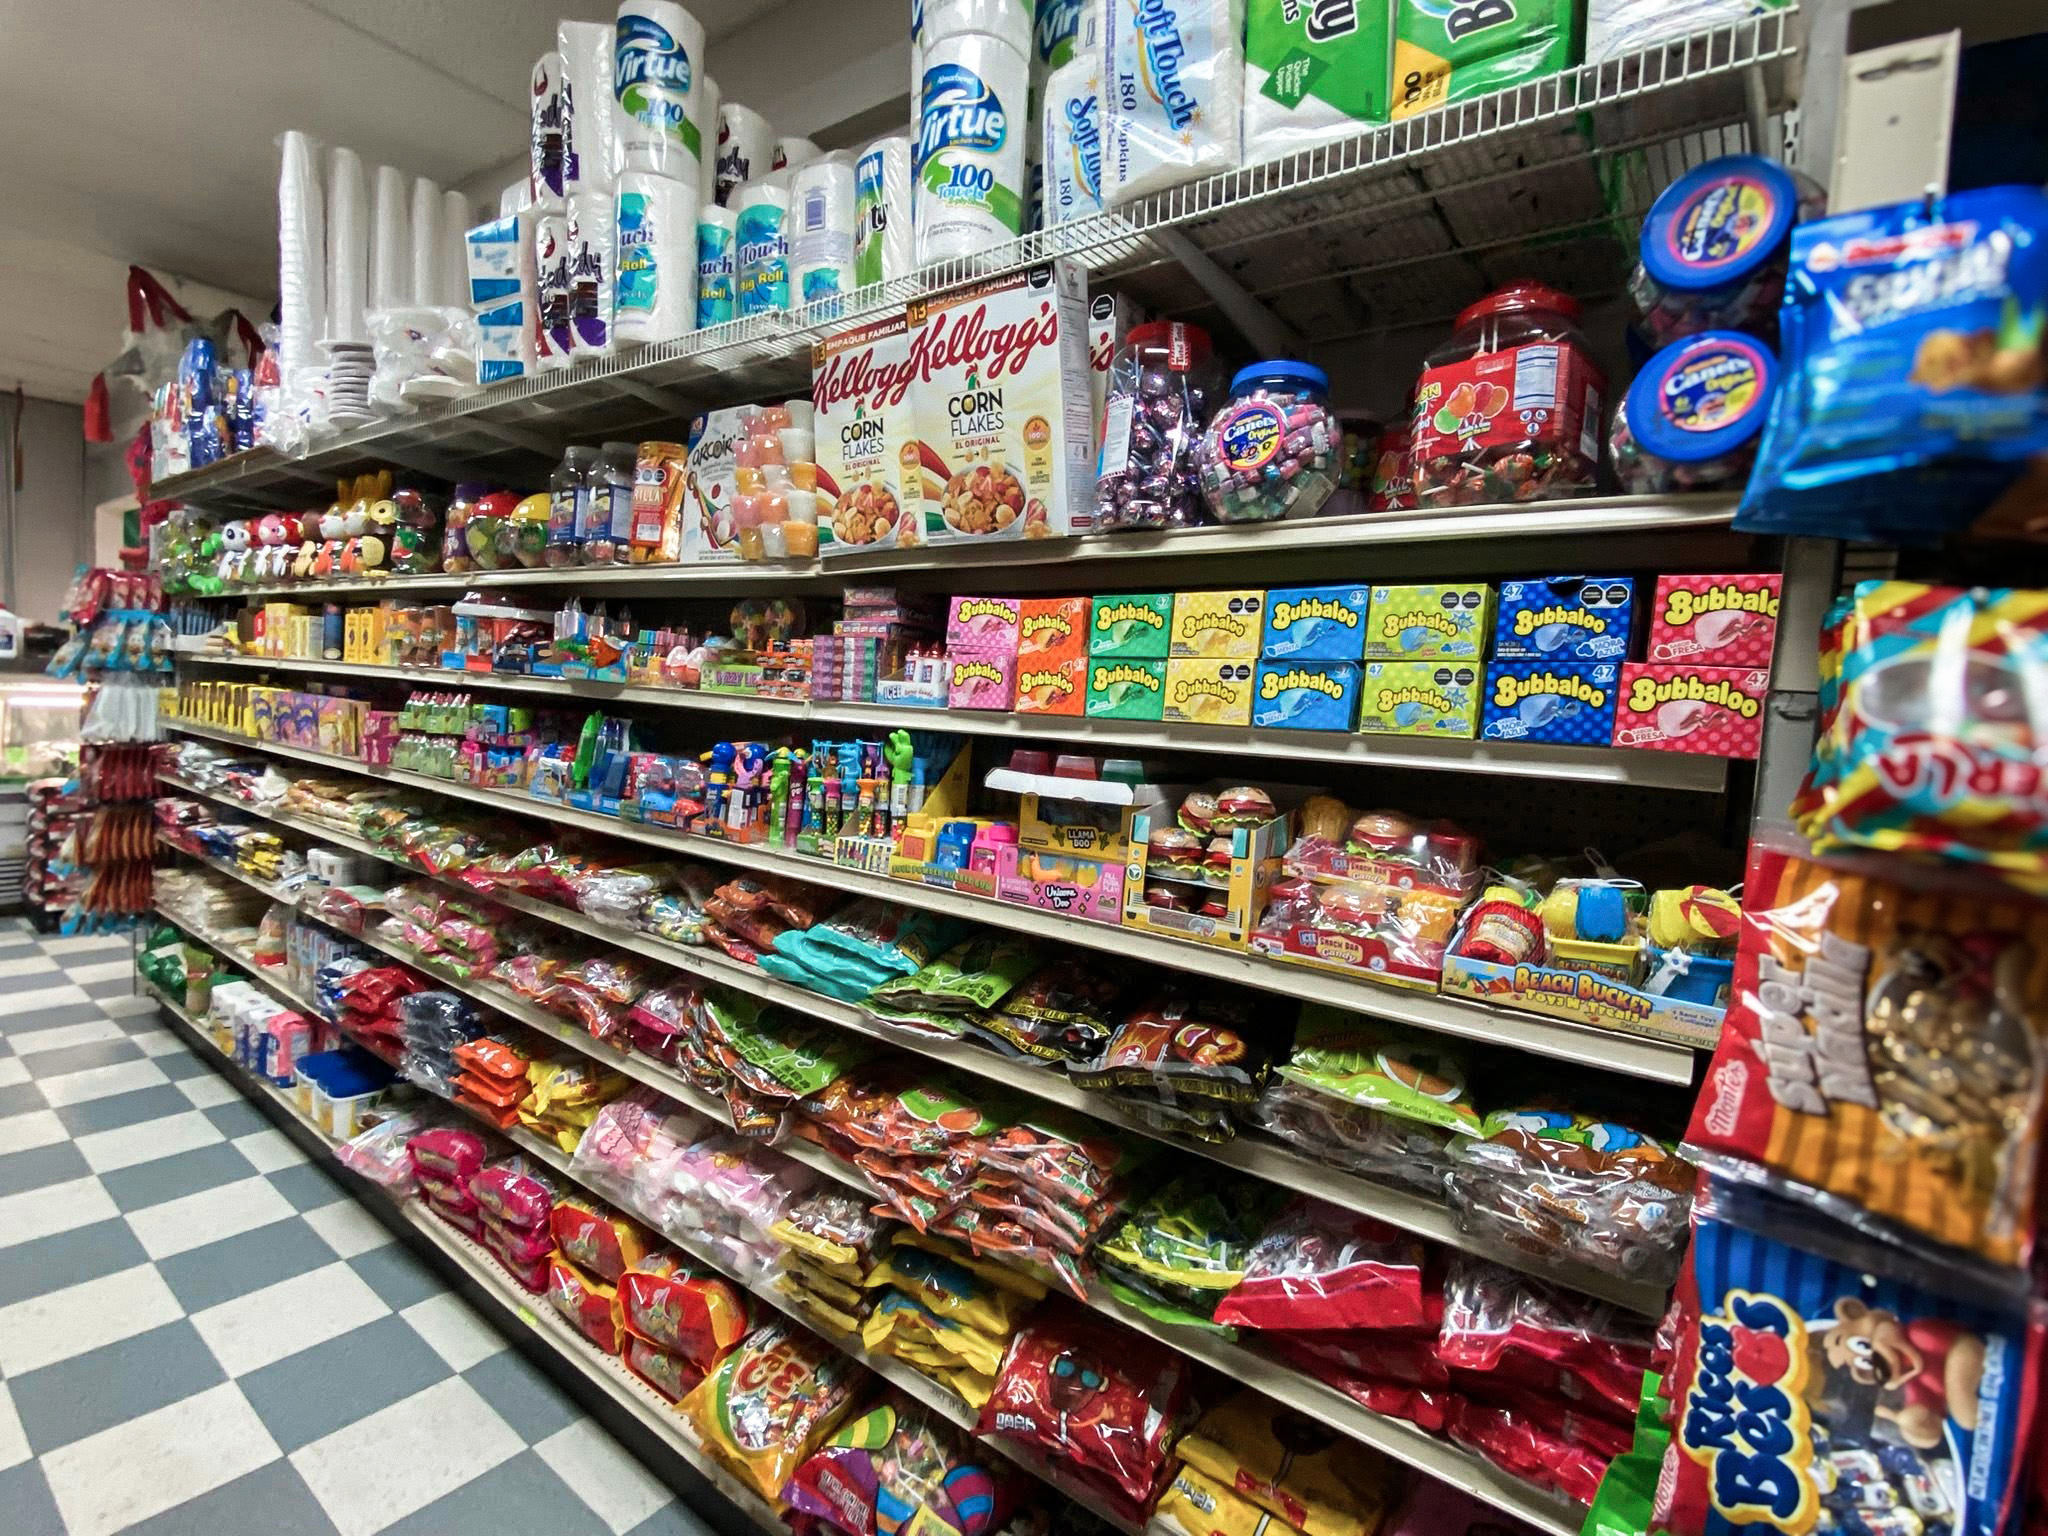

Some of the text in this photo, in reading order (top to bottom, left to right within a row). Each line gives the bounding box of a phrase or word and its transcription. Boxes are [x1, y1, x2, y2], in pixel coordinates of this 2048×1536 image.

[1119, 72, 1137, 110] 180
[949, 164, 994, 192] 100
[1059, 178, 1073, 206] 180
[758, 270, 784, 283] Roll
[826, 320, 907, 351] EMPAQUE FAMILIAR
[910, 301, 1058, 382] Kellogg's
[948, 388, 1003, 418] CORN
[841, 417, 884, 443] CORN
[950, 411, 1005, 438] FLAKES
[842, 438, 885, 461] FLAKES
[955, 437, 1000, 449] EL ORIGINAL
[1504, 585, 1523, 596] 47
[958, 600, 1018, 625] Bubbaloo
[1097, 603, 1164, 631] Bubbaloo
[1271, 597, 1359, 630] Bubbaloo
[1383, 611, 1459, 638] Bubbaloo
[1514, 605, 1606, 636] Bubbaloo
[1022, 614, 1072, 639] Bubbaloo
[1182, 614, 1246, 638] Bubbaloo
[1594, 638, 1624, 650] MORA
[1671, 643, 1703, 656] FRESA
[953, 661, 1002, 686] Bubbaloo
[1020, 671, 1074, 695] Bubbaloo
[1093, 665, 1160, 693] Bubbaloo
[1593, 665, 1615, 677] 47
[1747, 671, 1769, 686] 47
[1174, 678, 1237, 704] Bubbaloo
[1260, 668, 1344, 701] Bubbaloo
[1494, 672, 1606, 708] Bubbaloo
[1628, 675, 1759, 718] Bubbaloo
[1377, 686, 1452, 713] Bubbaloo
[1500, 722, 1528, 731] MORA
[1635, 731, 1665, 742] FRESA
[1067, 828, 1096, 840] LLAMA
[1352, 872, 1386, 884] Candy
[1319, 937, 1344, 949] SNACK
[1321, 948, 1358, 963] Candy
[1513, 966, 1654, 1020] BEACH BUCKET
[1524, 988, 1564, 1006] Toys
[1709, 1064, 1743, 1133] Montes
